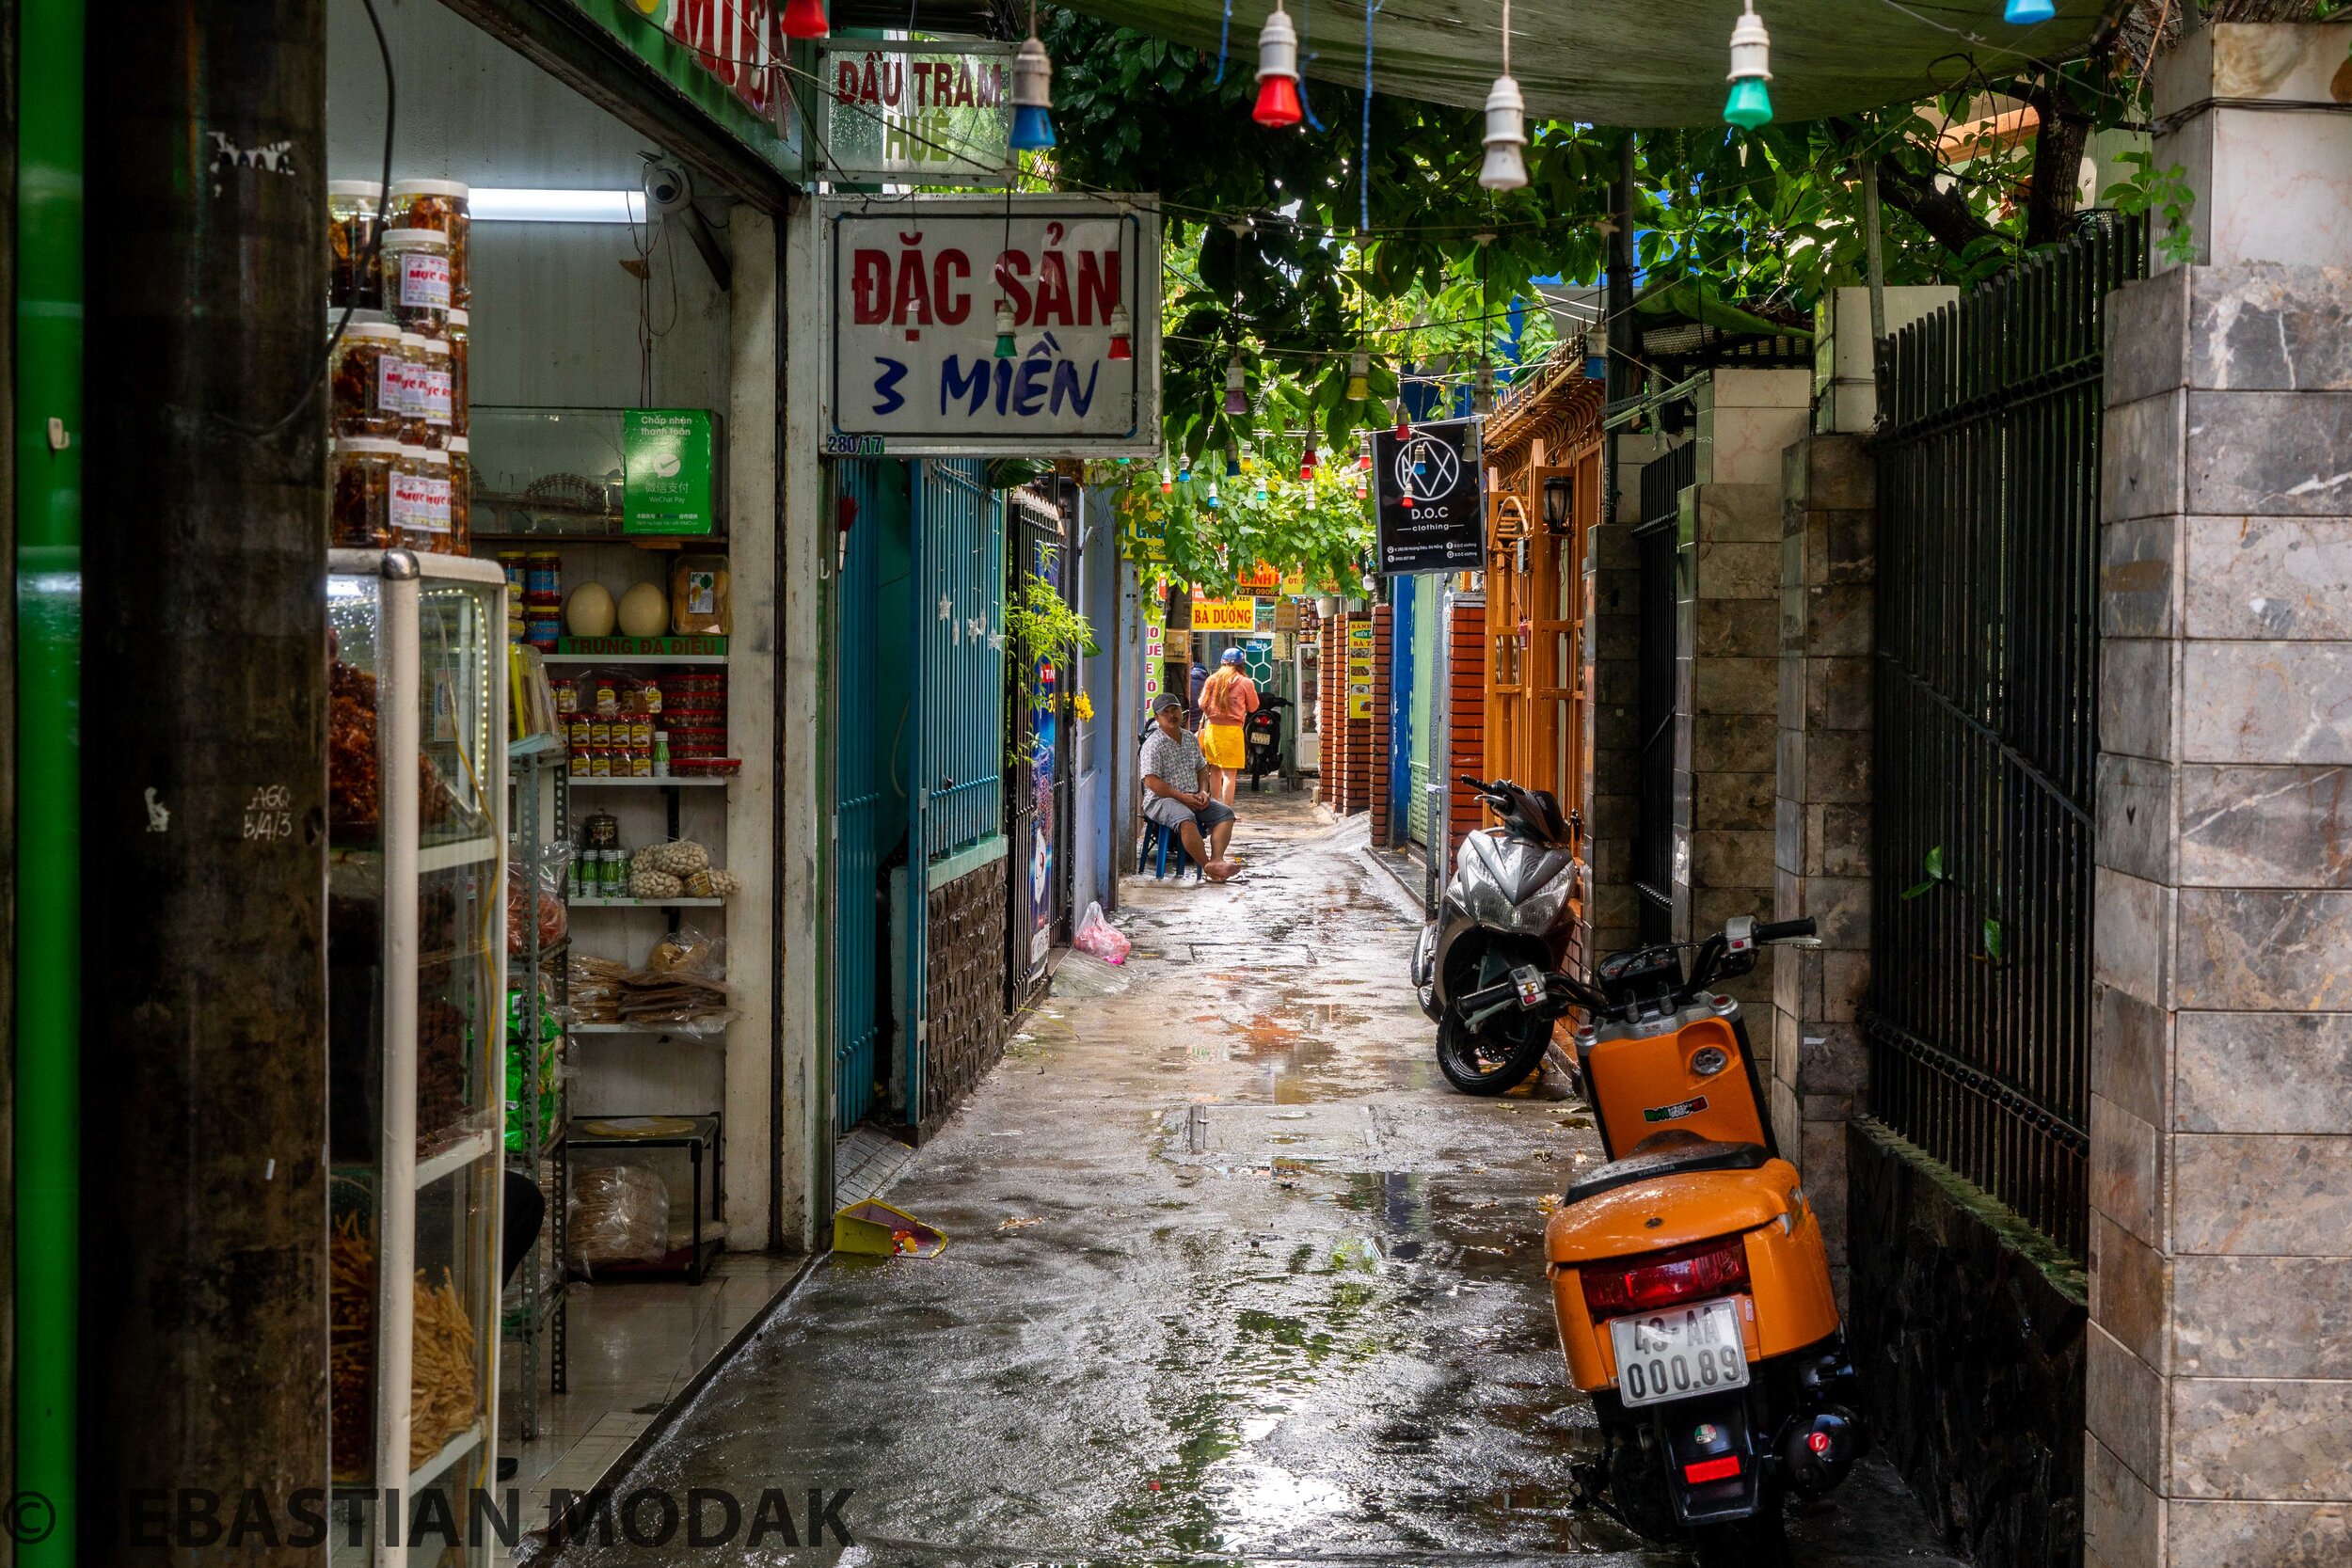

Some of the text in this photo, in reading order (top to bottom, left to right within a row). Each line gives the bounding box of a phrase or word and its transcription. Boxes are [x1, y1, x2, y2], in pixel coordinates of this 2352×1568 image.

[851, 222, 1121, 342] ĐẶC SẢN
[872, 331, 1100, 419] 3 MIỀN
[828, 436, 884, 454] 280/17
[645, 482, 689, 494] 微信支付
[675, 497, 686, 505] Pay
[1411, 507, 1449, 520] D.O.C
[1412, 524, 1450, 532] clothing
[1194, 604, 1209, 624] BÀ
[1638, 1165, 1676, 1178] YAMAHA
[1628, 1345, 1740, 1399] 000.89
